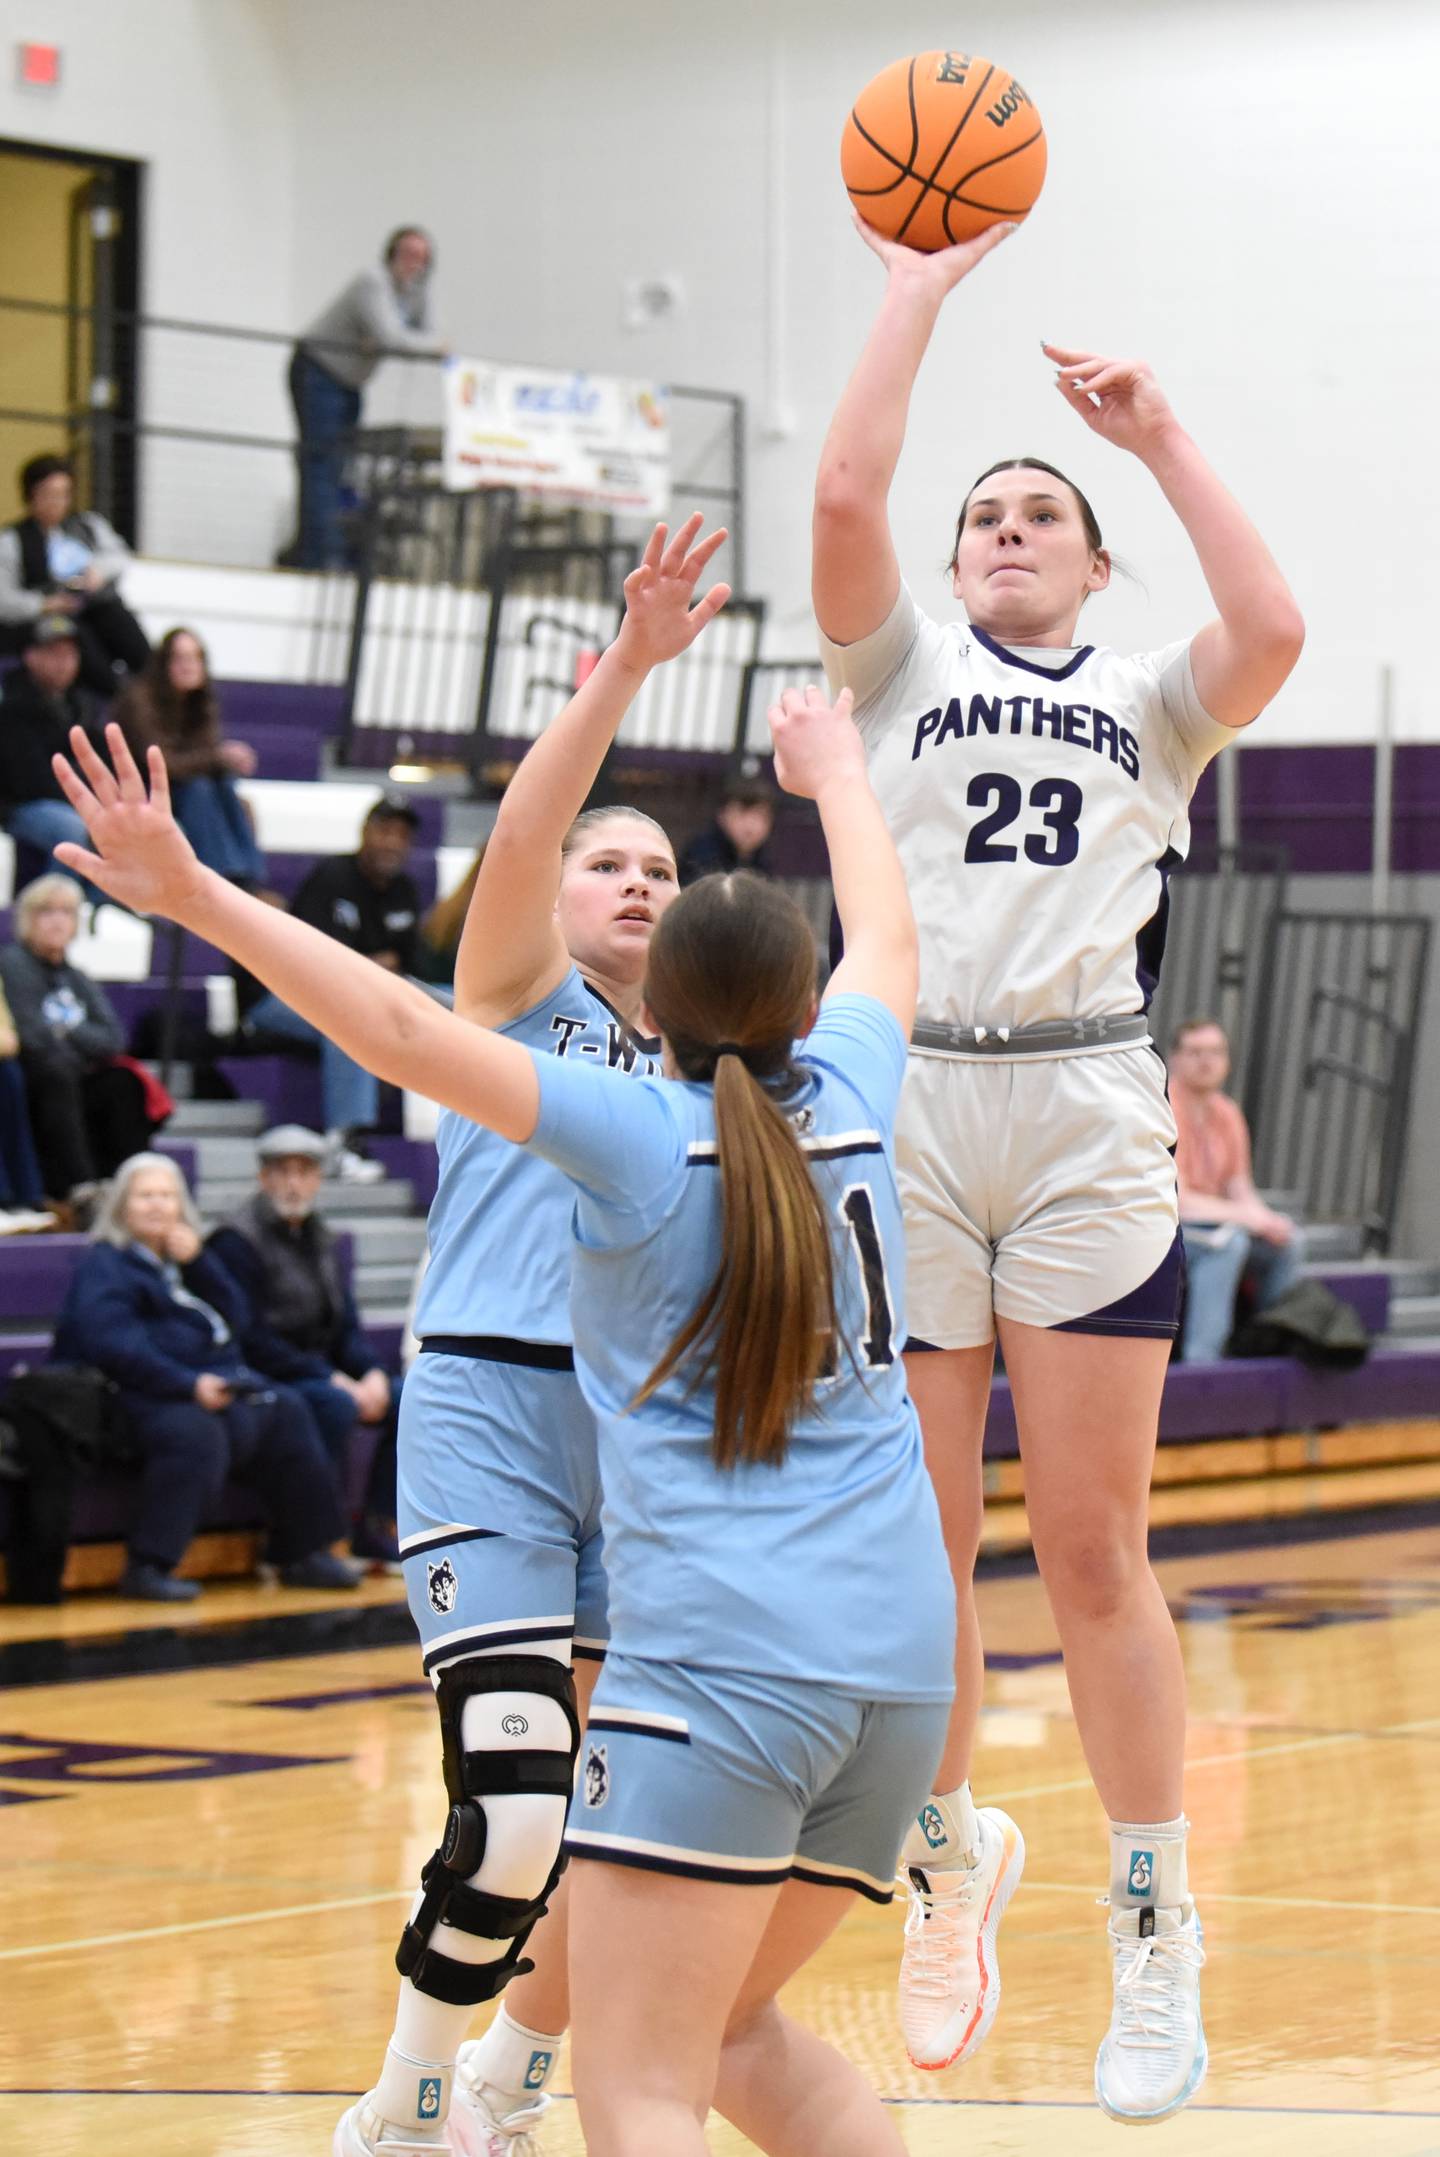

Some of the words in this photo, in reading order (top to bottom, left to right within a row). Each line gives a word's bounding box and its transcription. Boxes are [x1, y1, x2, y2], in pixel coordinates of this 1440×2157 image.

[912, 693, 1140, 781] PANTHERS
[964, 772, 1083, 867] 23
[549, 1013, 663, 1077] T-W
